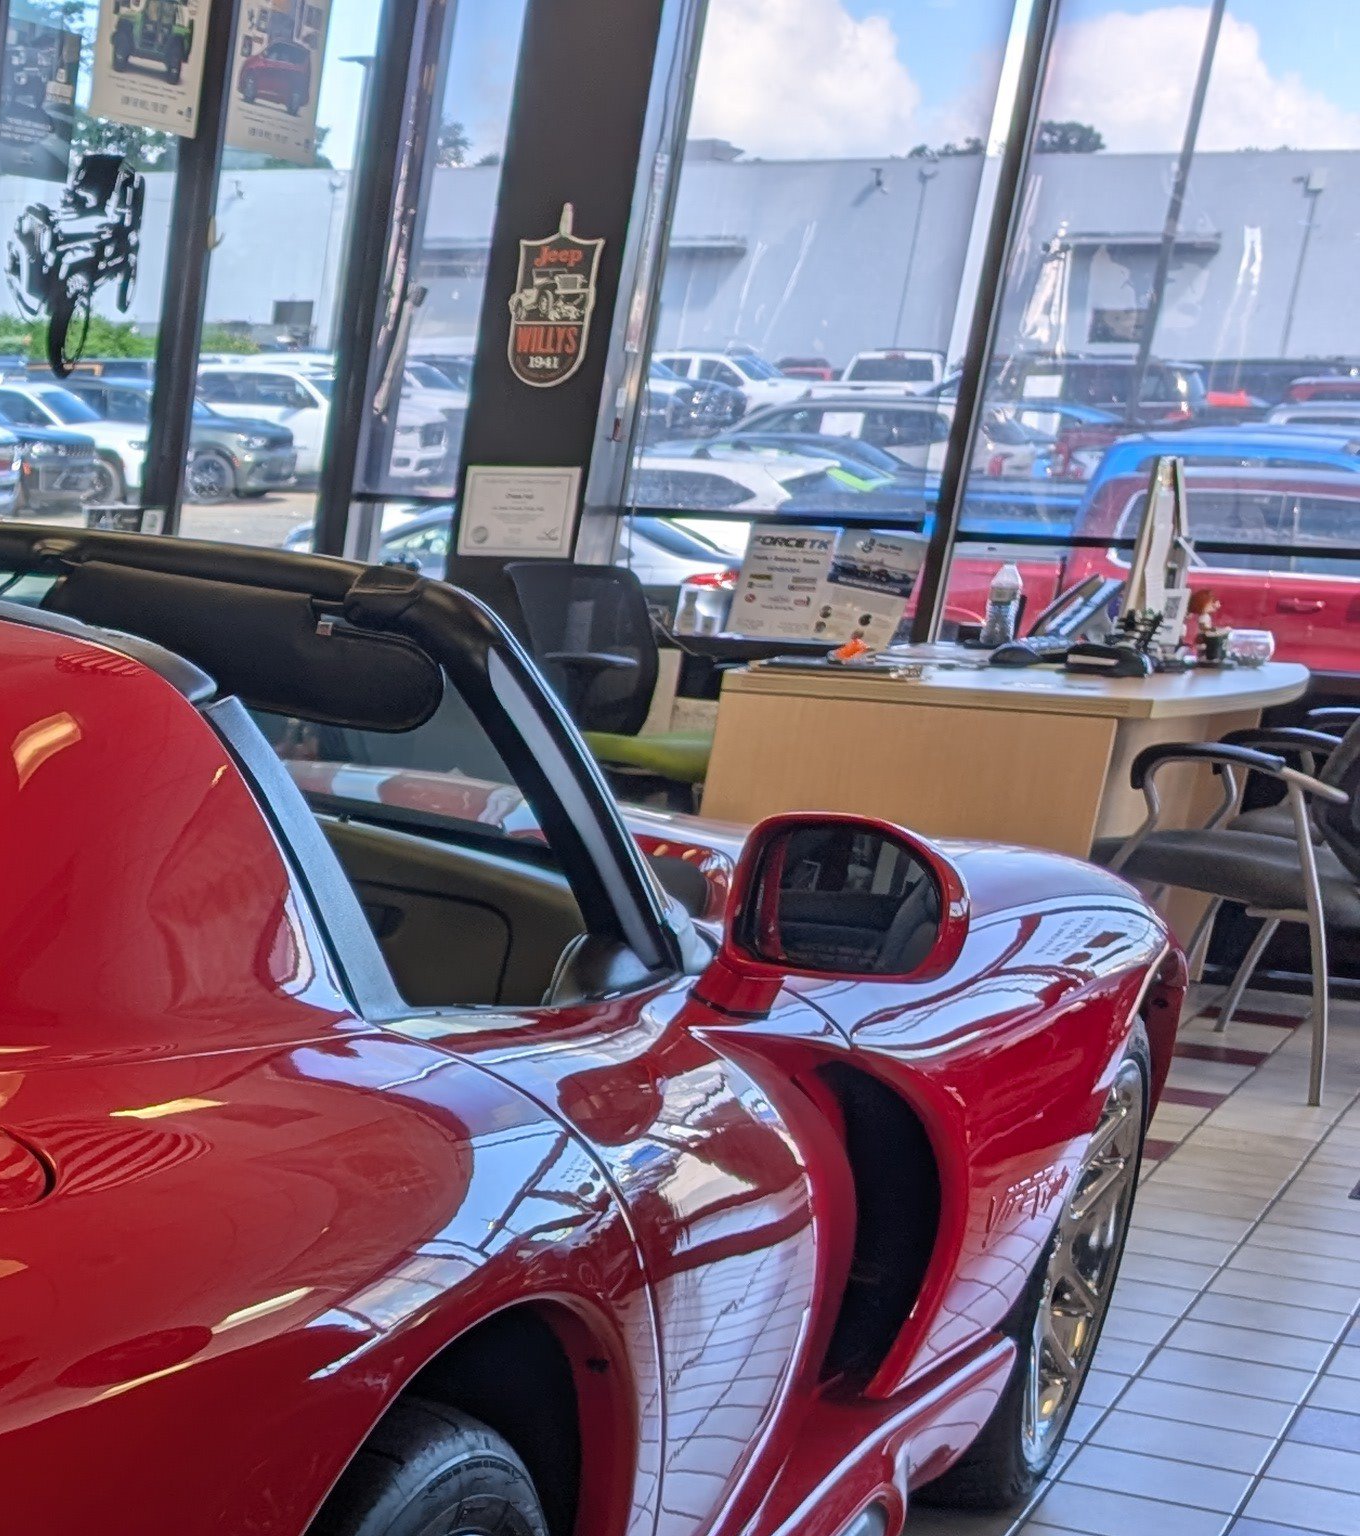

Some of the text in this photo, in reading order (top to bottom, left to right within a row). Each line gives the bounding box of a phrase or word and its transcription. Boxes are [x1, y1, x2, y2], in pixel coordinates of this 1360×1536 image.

[533, 245, 584, 268] Jeep
[515, 325, 579, 354] WILLYS
[527, 355, 560, 370] 1941
